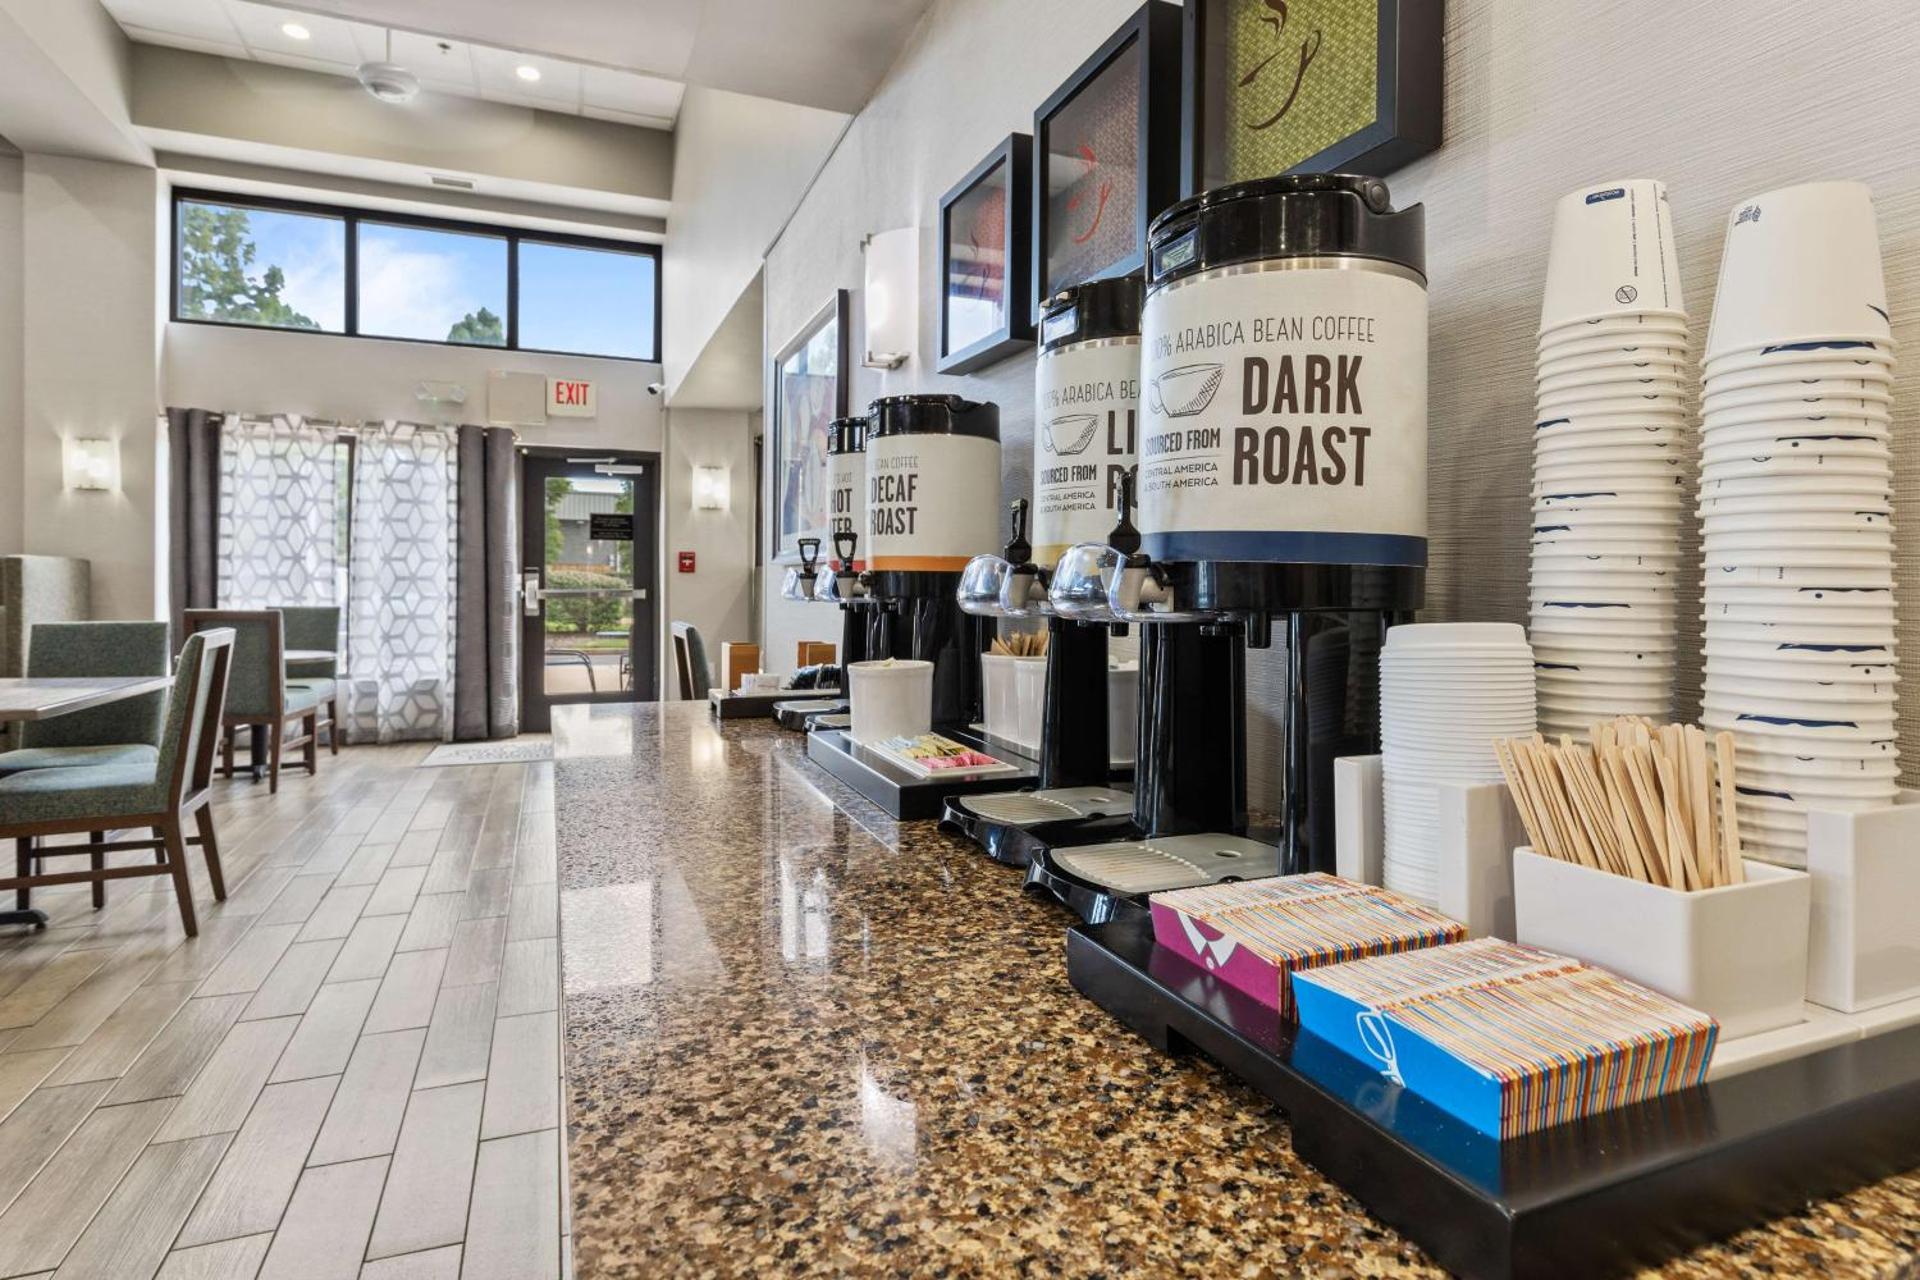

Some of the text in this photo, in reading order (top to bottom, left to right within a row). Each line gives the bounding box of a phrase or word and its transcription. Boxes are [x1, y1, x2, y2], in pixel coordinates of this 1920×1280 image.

[1175, 320, 1245, 354] ARABICA
[1253, 317, 1304, 343] BEAN
[1312, 315, 1376, 343] COFFEE
[555, 381, 590, 406] EXIT
[1061, 381, 1115, 406] ARABICA
[1120, 379, 1141, 400] BE
[1242, 354, 1363, 416] DARK
[1186, 427, 1222, 450] FROM
[1174, 462, 1218, 475] AMERICA
[1232, 425, 1372, 487] ROAST
[1071, 464, 1098, 481] FROM
[1172, 477, 1218, 489] AMERICA
[871, 473, 918, 504] DECAF
[870, 506, 918, 537] ROAST
